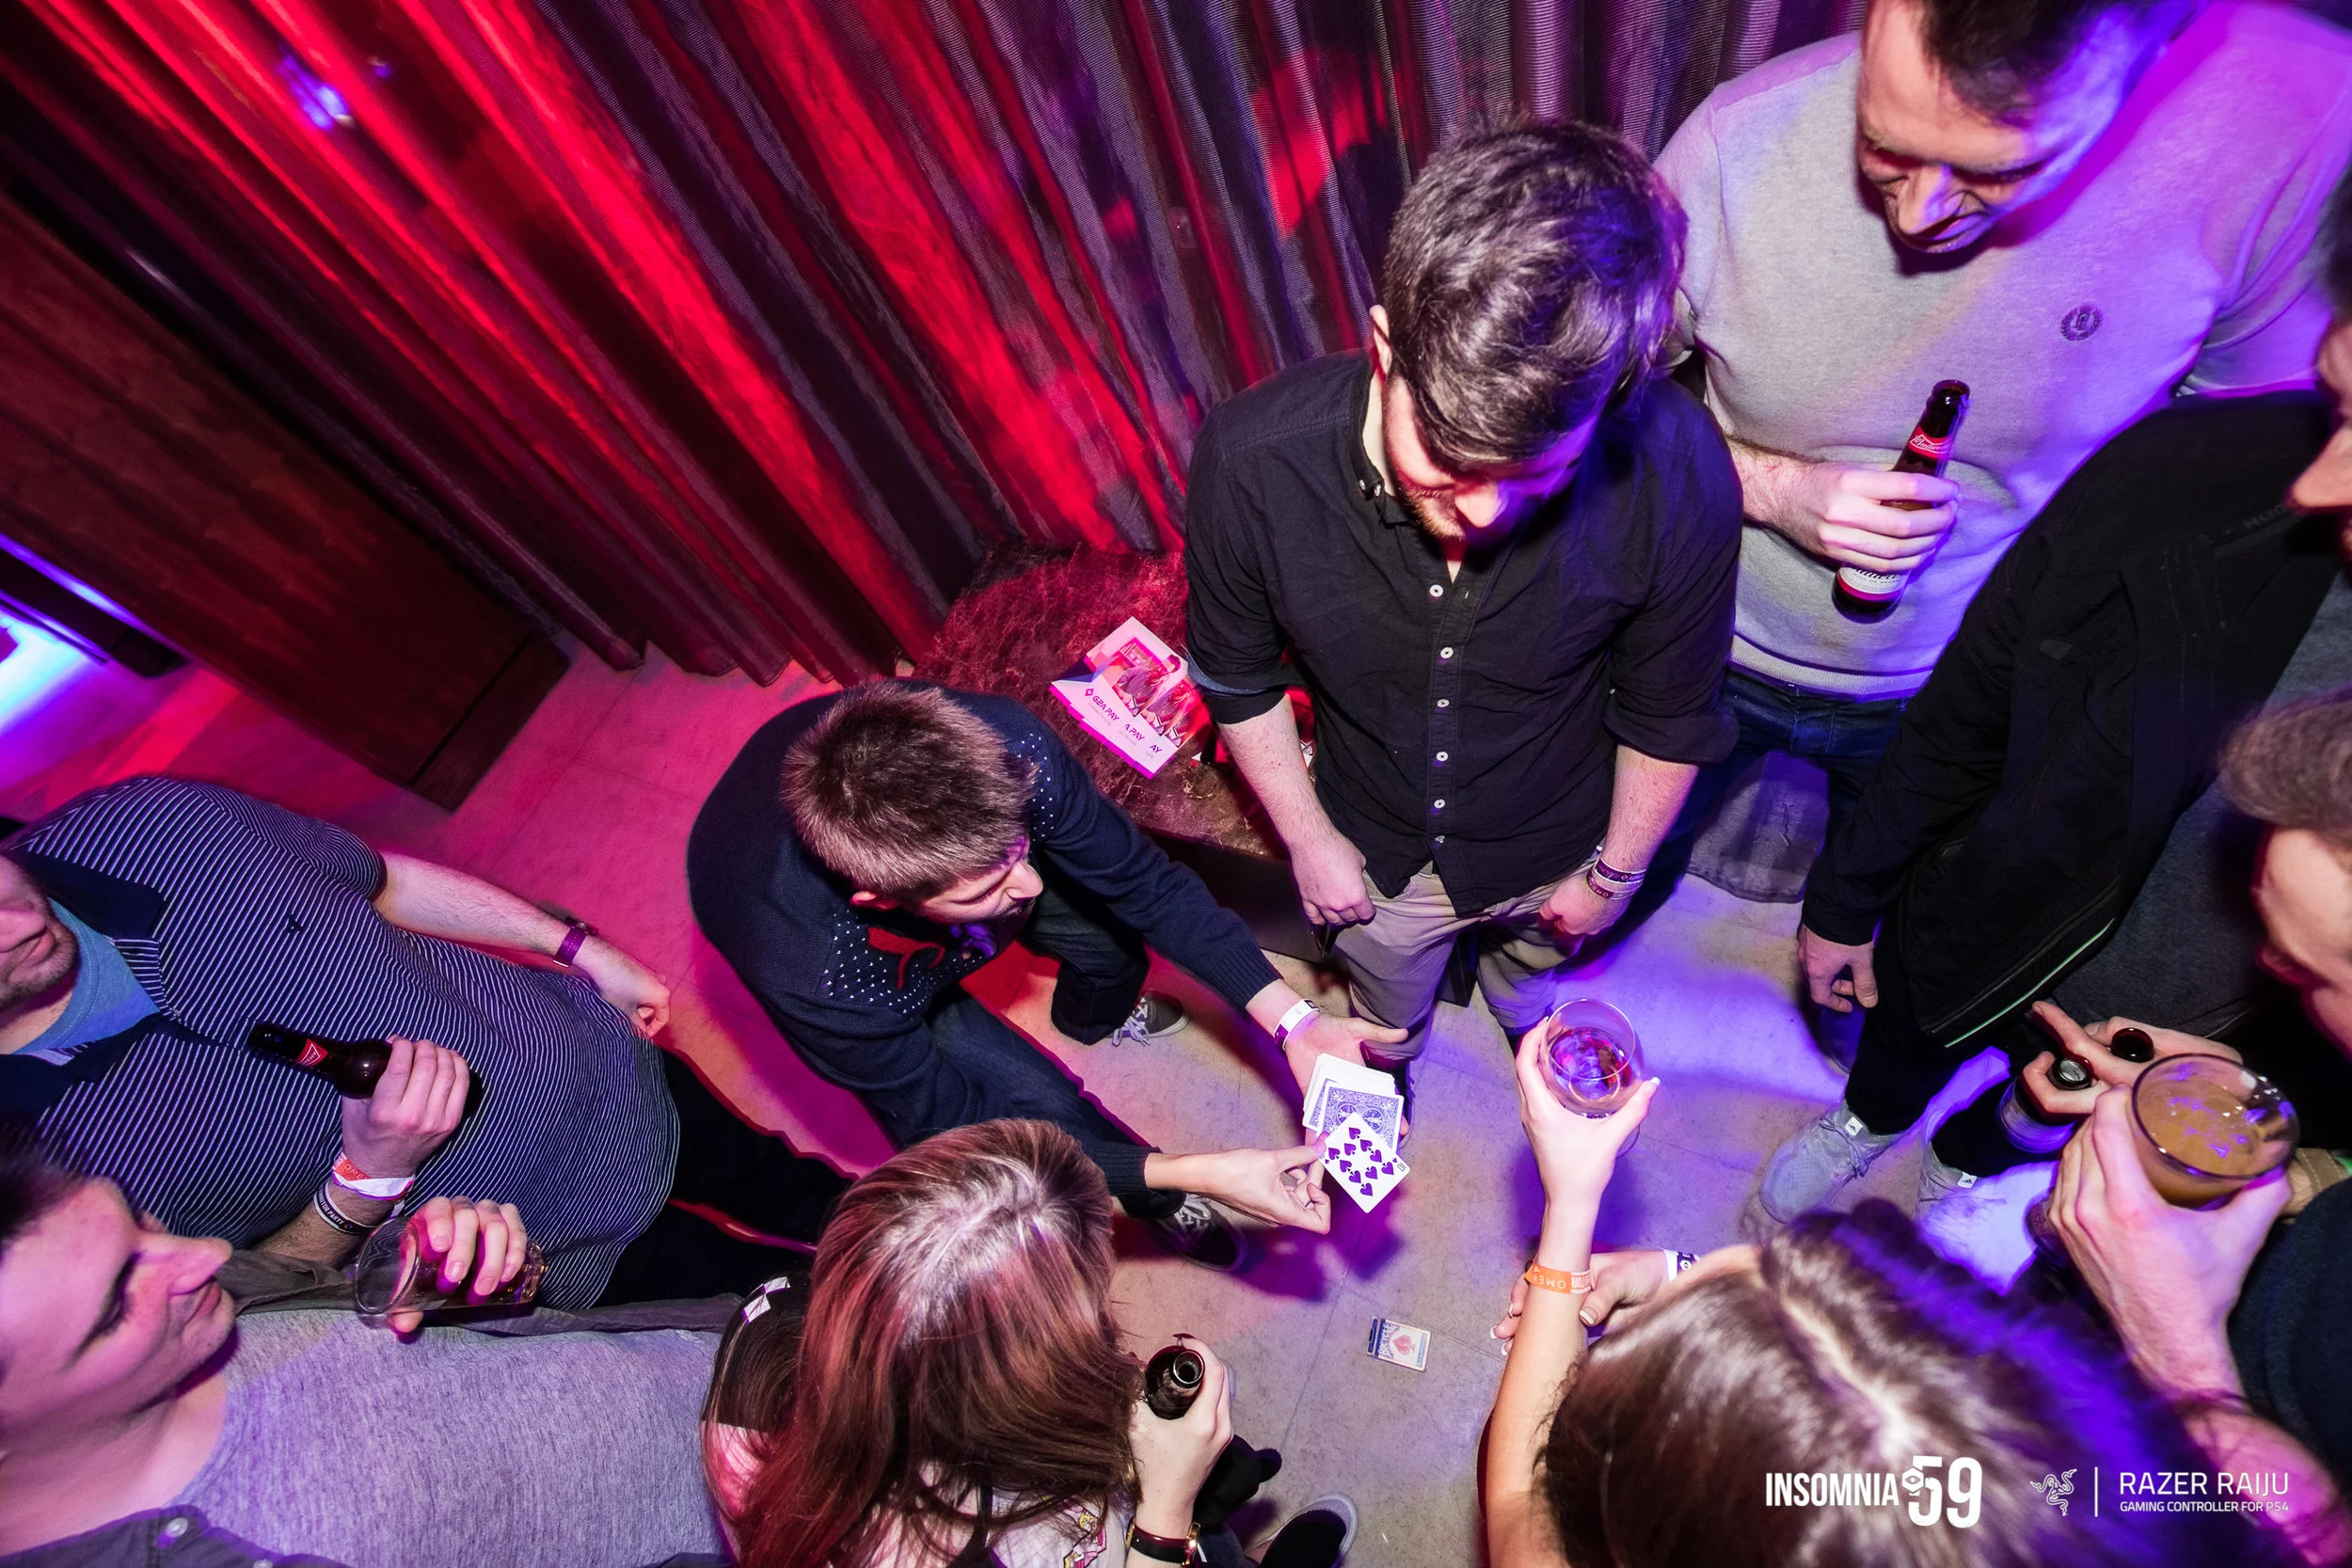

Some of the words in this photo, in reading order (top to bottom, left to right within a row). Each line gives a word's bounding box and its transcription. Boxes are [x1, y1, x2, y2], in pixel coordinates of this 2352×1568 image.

[1105, 707, 1120, 721] PAY
[1129, 727, 1145, 742] PAY
[1149, 744, 1163, 753] AY
[326, 1210, 345, 1225] PARTY
[1532, 1274, 1566, 1290] OMEN
